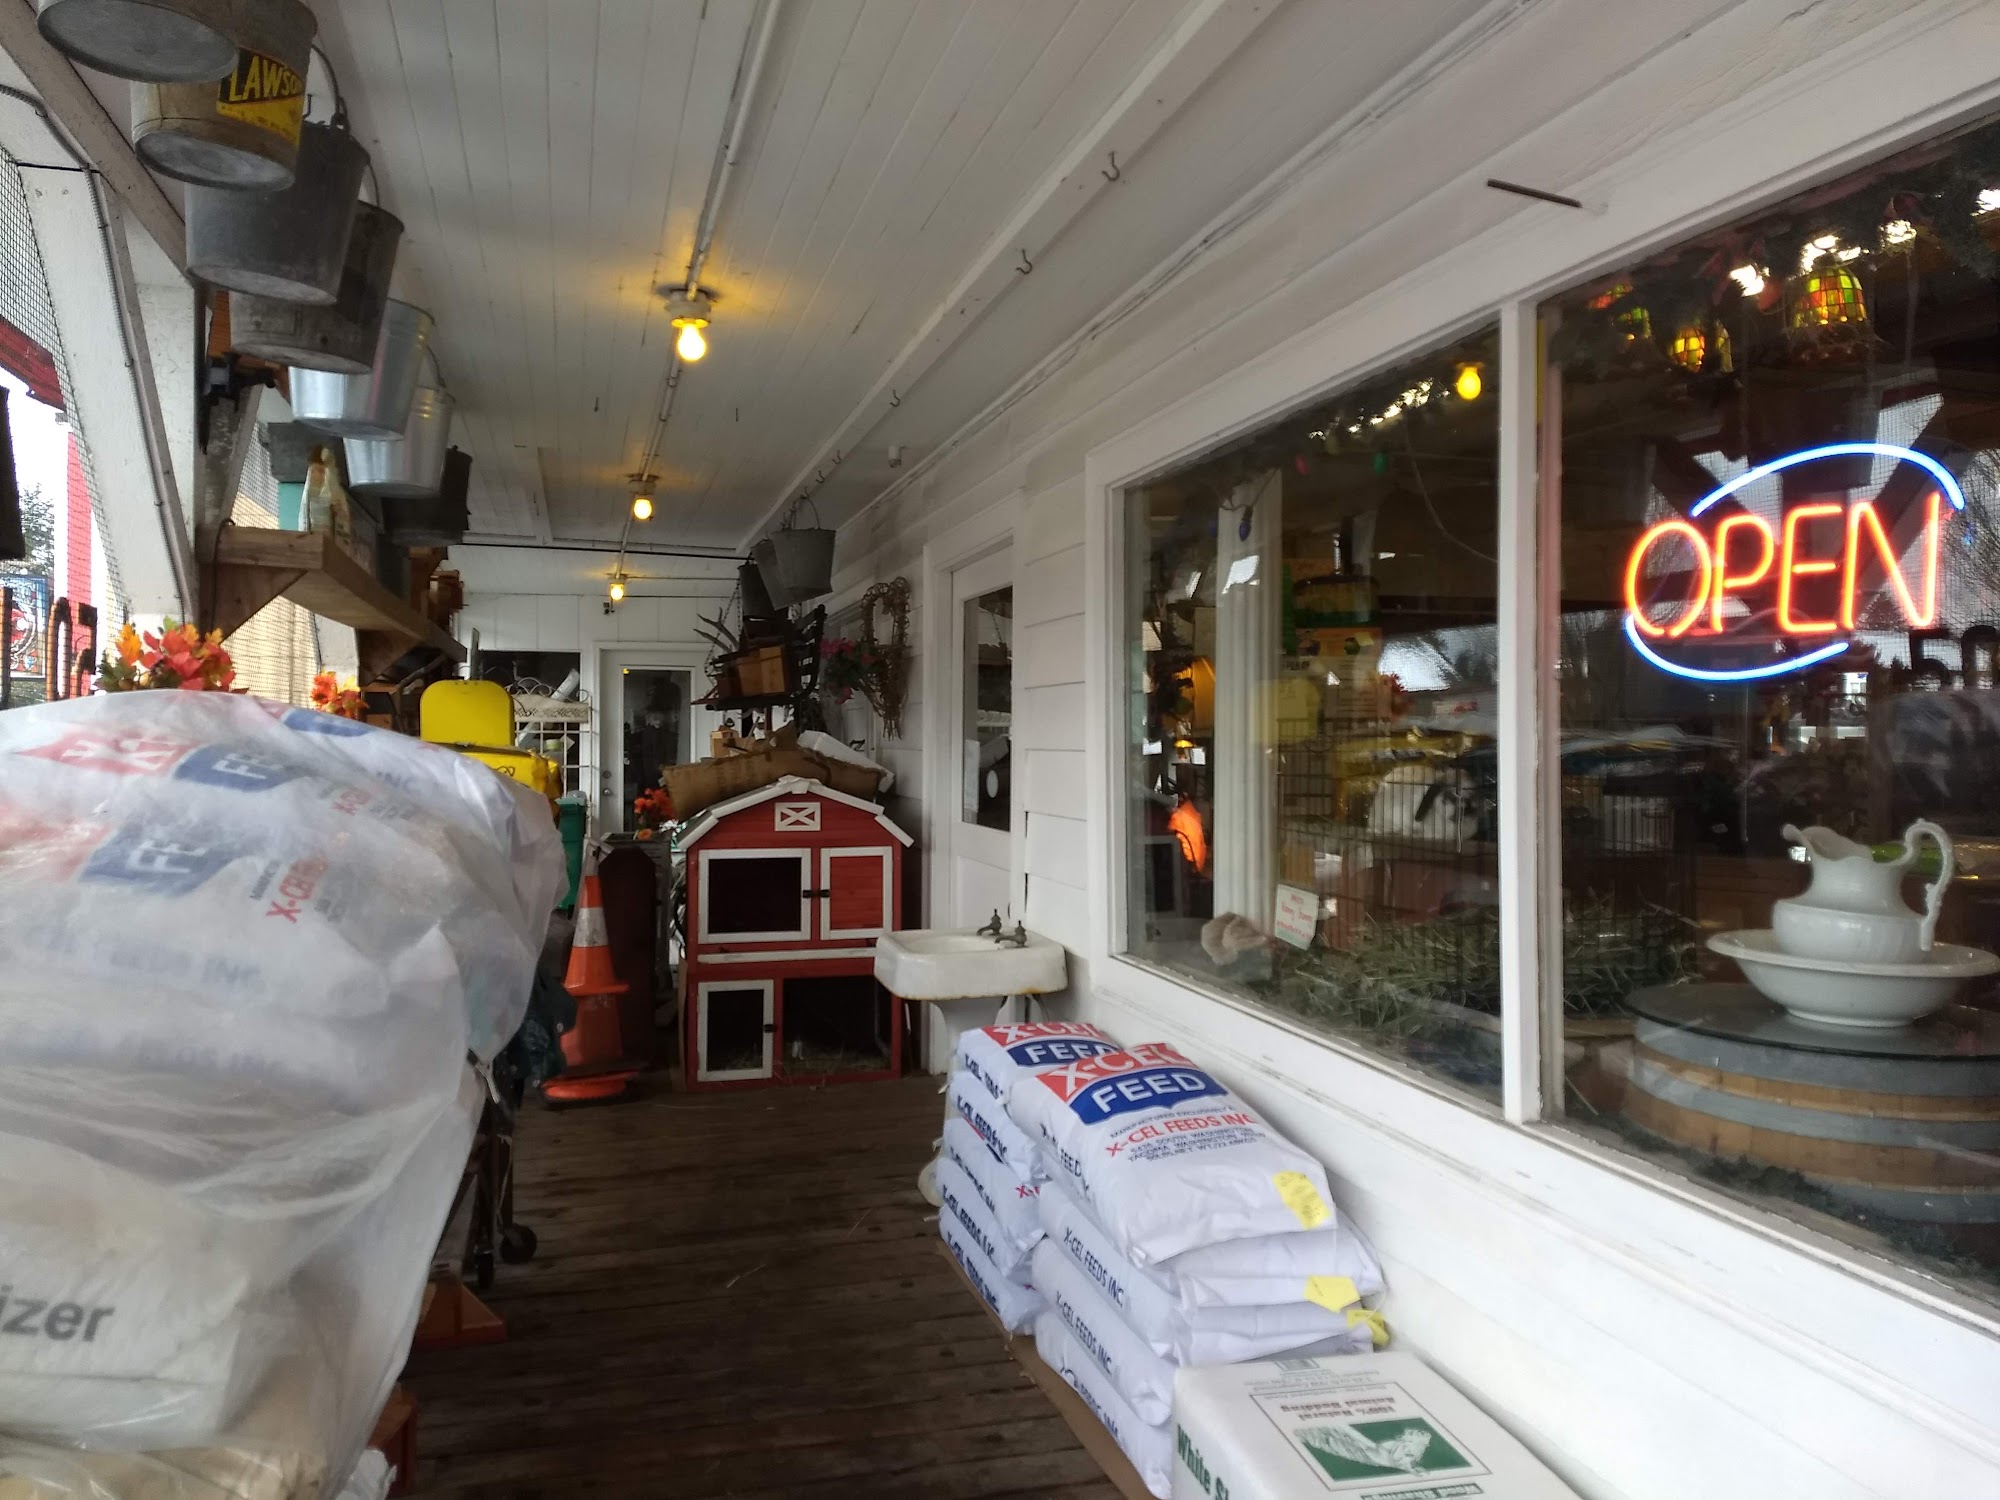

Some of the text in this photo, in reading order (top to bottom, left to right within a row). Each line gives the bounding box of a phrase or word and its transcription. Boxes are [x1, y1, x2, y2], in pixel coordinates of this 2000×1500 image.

[229, 55, 303, 101] LAWSO
[1624, 490, 1941, 638] OPEN
[1048, 1042, 1191, 1098] X-CEL
[1091, 1072, 1206, 1114] FEED
[1105, 1125, 1165, 1157] X-CEL
[1163, 1115, 1221, 1134] FEEDS
[1063, 1227, 1084, 1262] X-CEL
[1083, 1250, 1107, 1288] FEEDS
[1075, 1317, 1097, 1356] FEEDS
[1177, 1423, 1211, 1495] White
